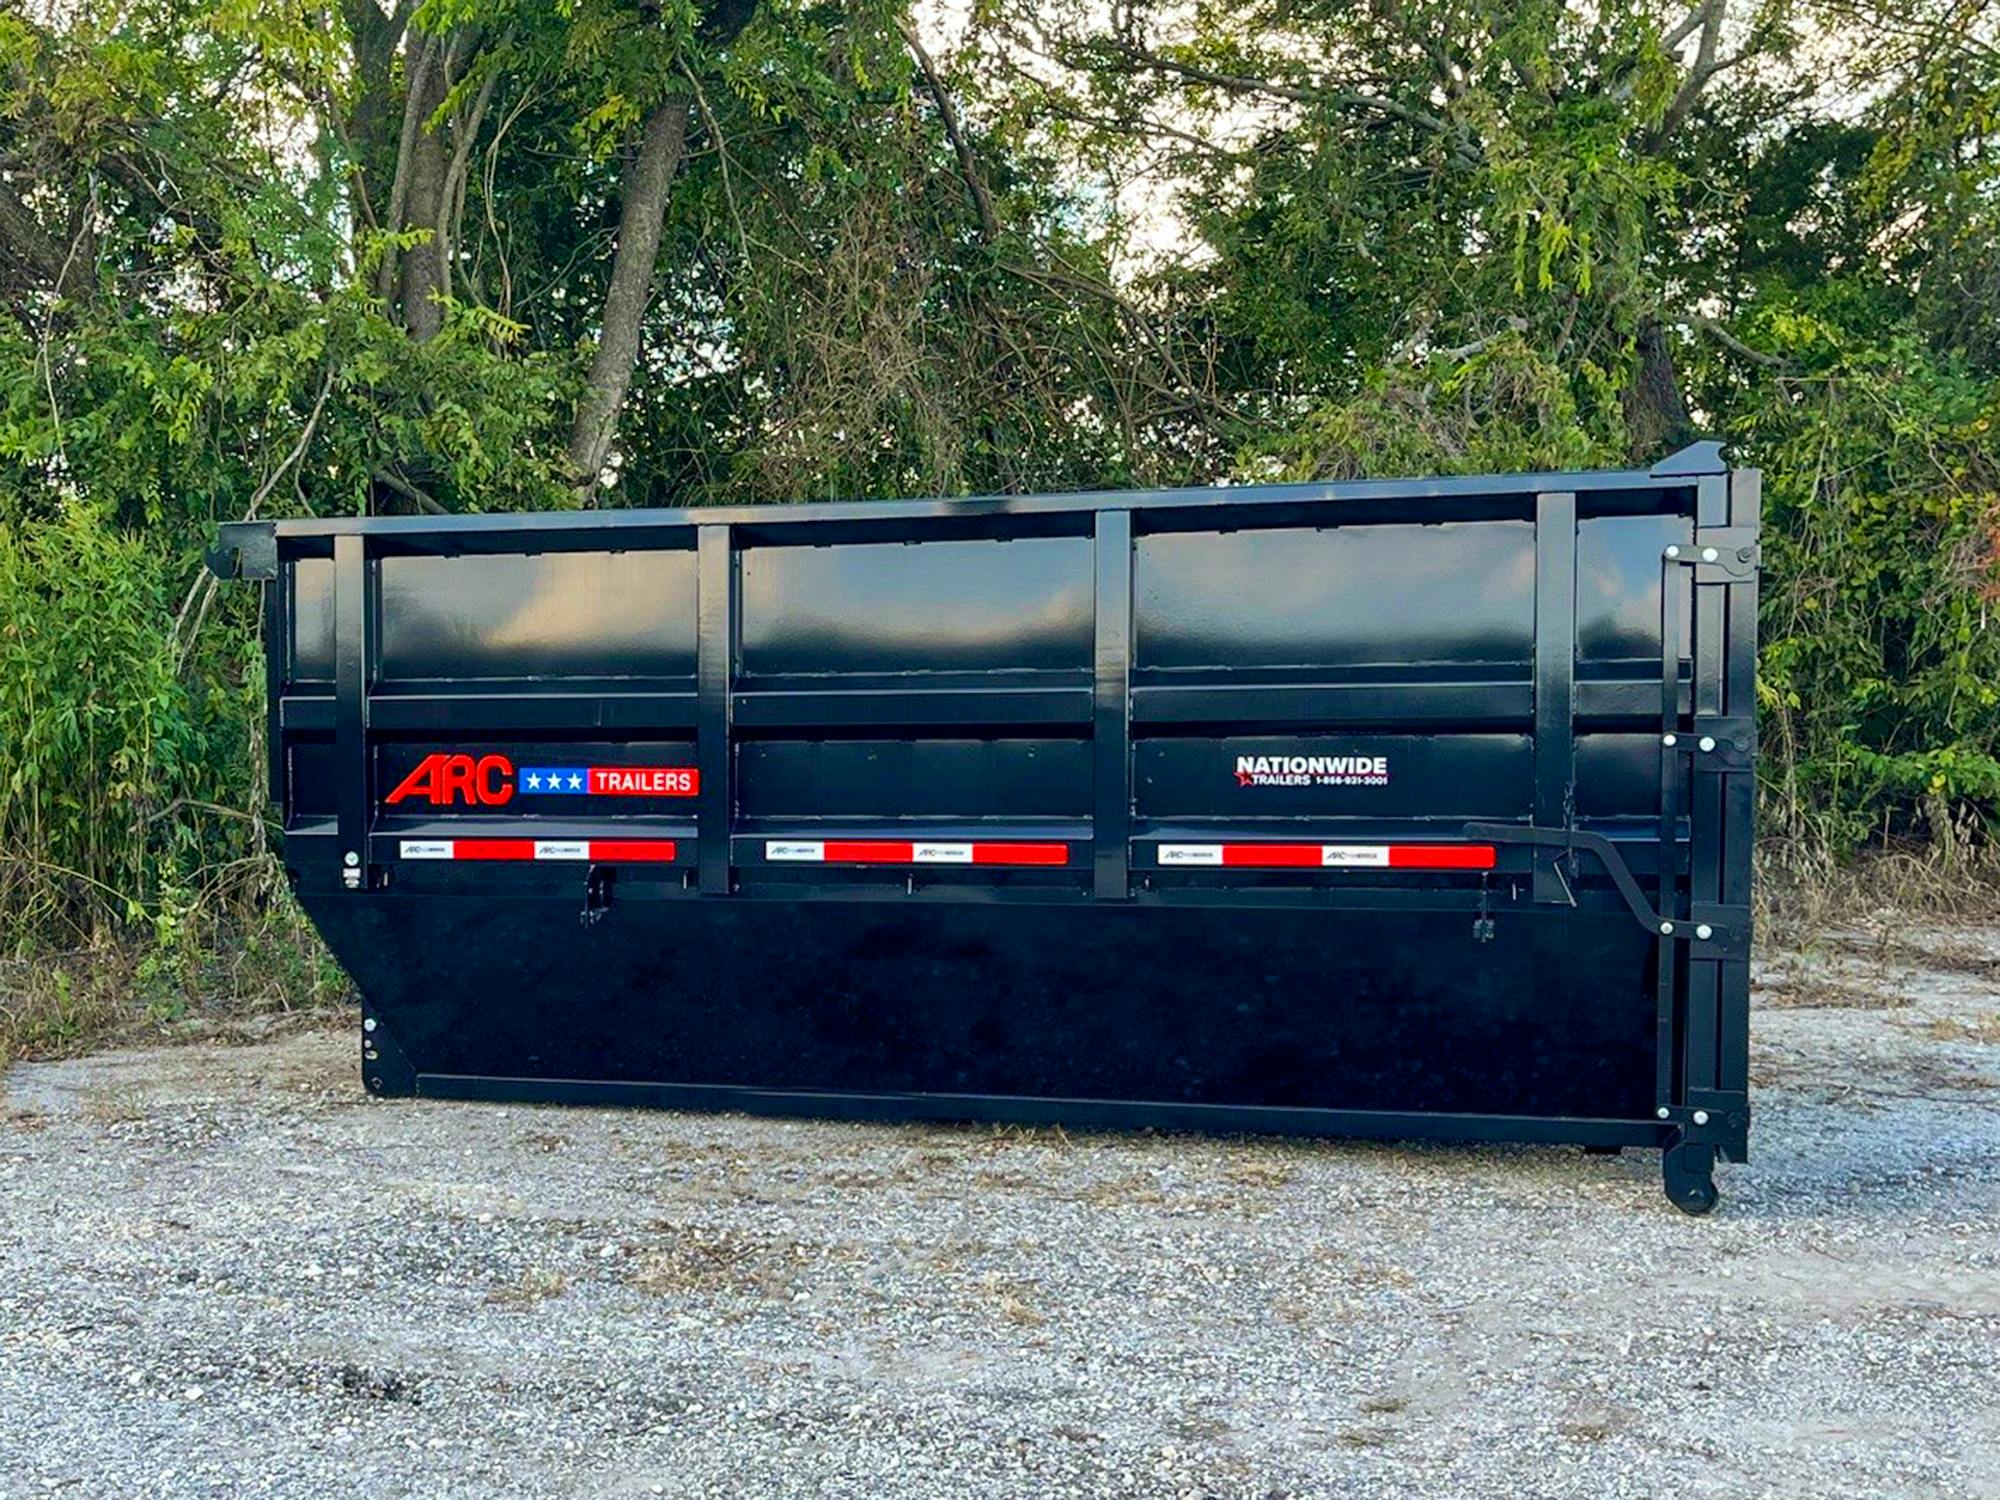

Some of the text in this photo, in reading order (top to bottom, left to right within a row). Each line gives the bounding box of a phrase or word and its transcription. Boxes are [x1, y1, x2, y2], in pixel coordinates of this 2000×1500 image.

[1237, 756, 1388, 774] NATIONWIDE
[384, 754, 691, 805] ARC TRAILERS
[1252, 774, 1311, 786] TRAILERS
